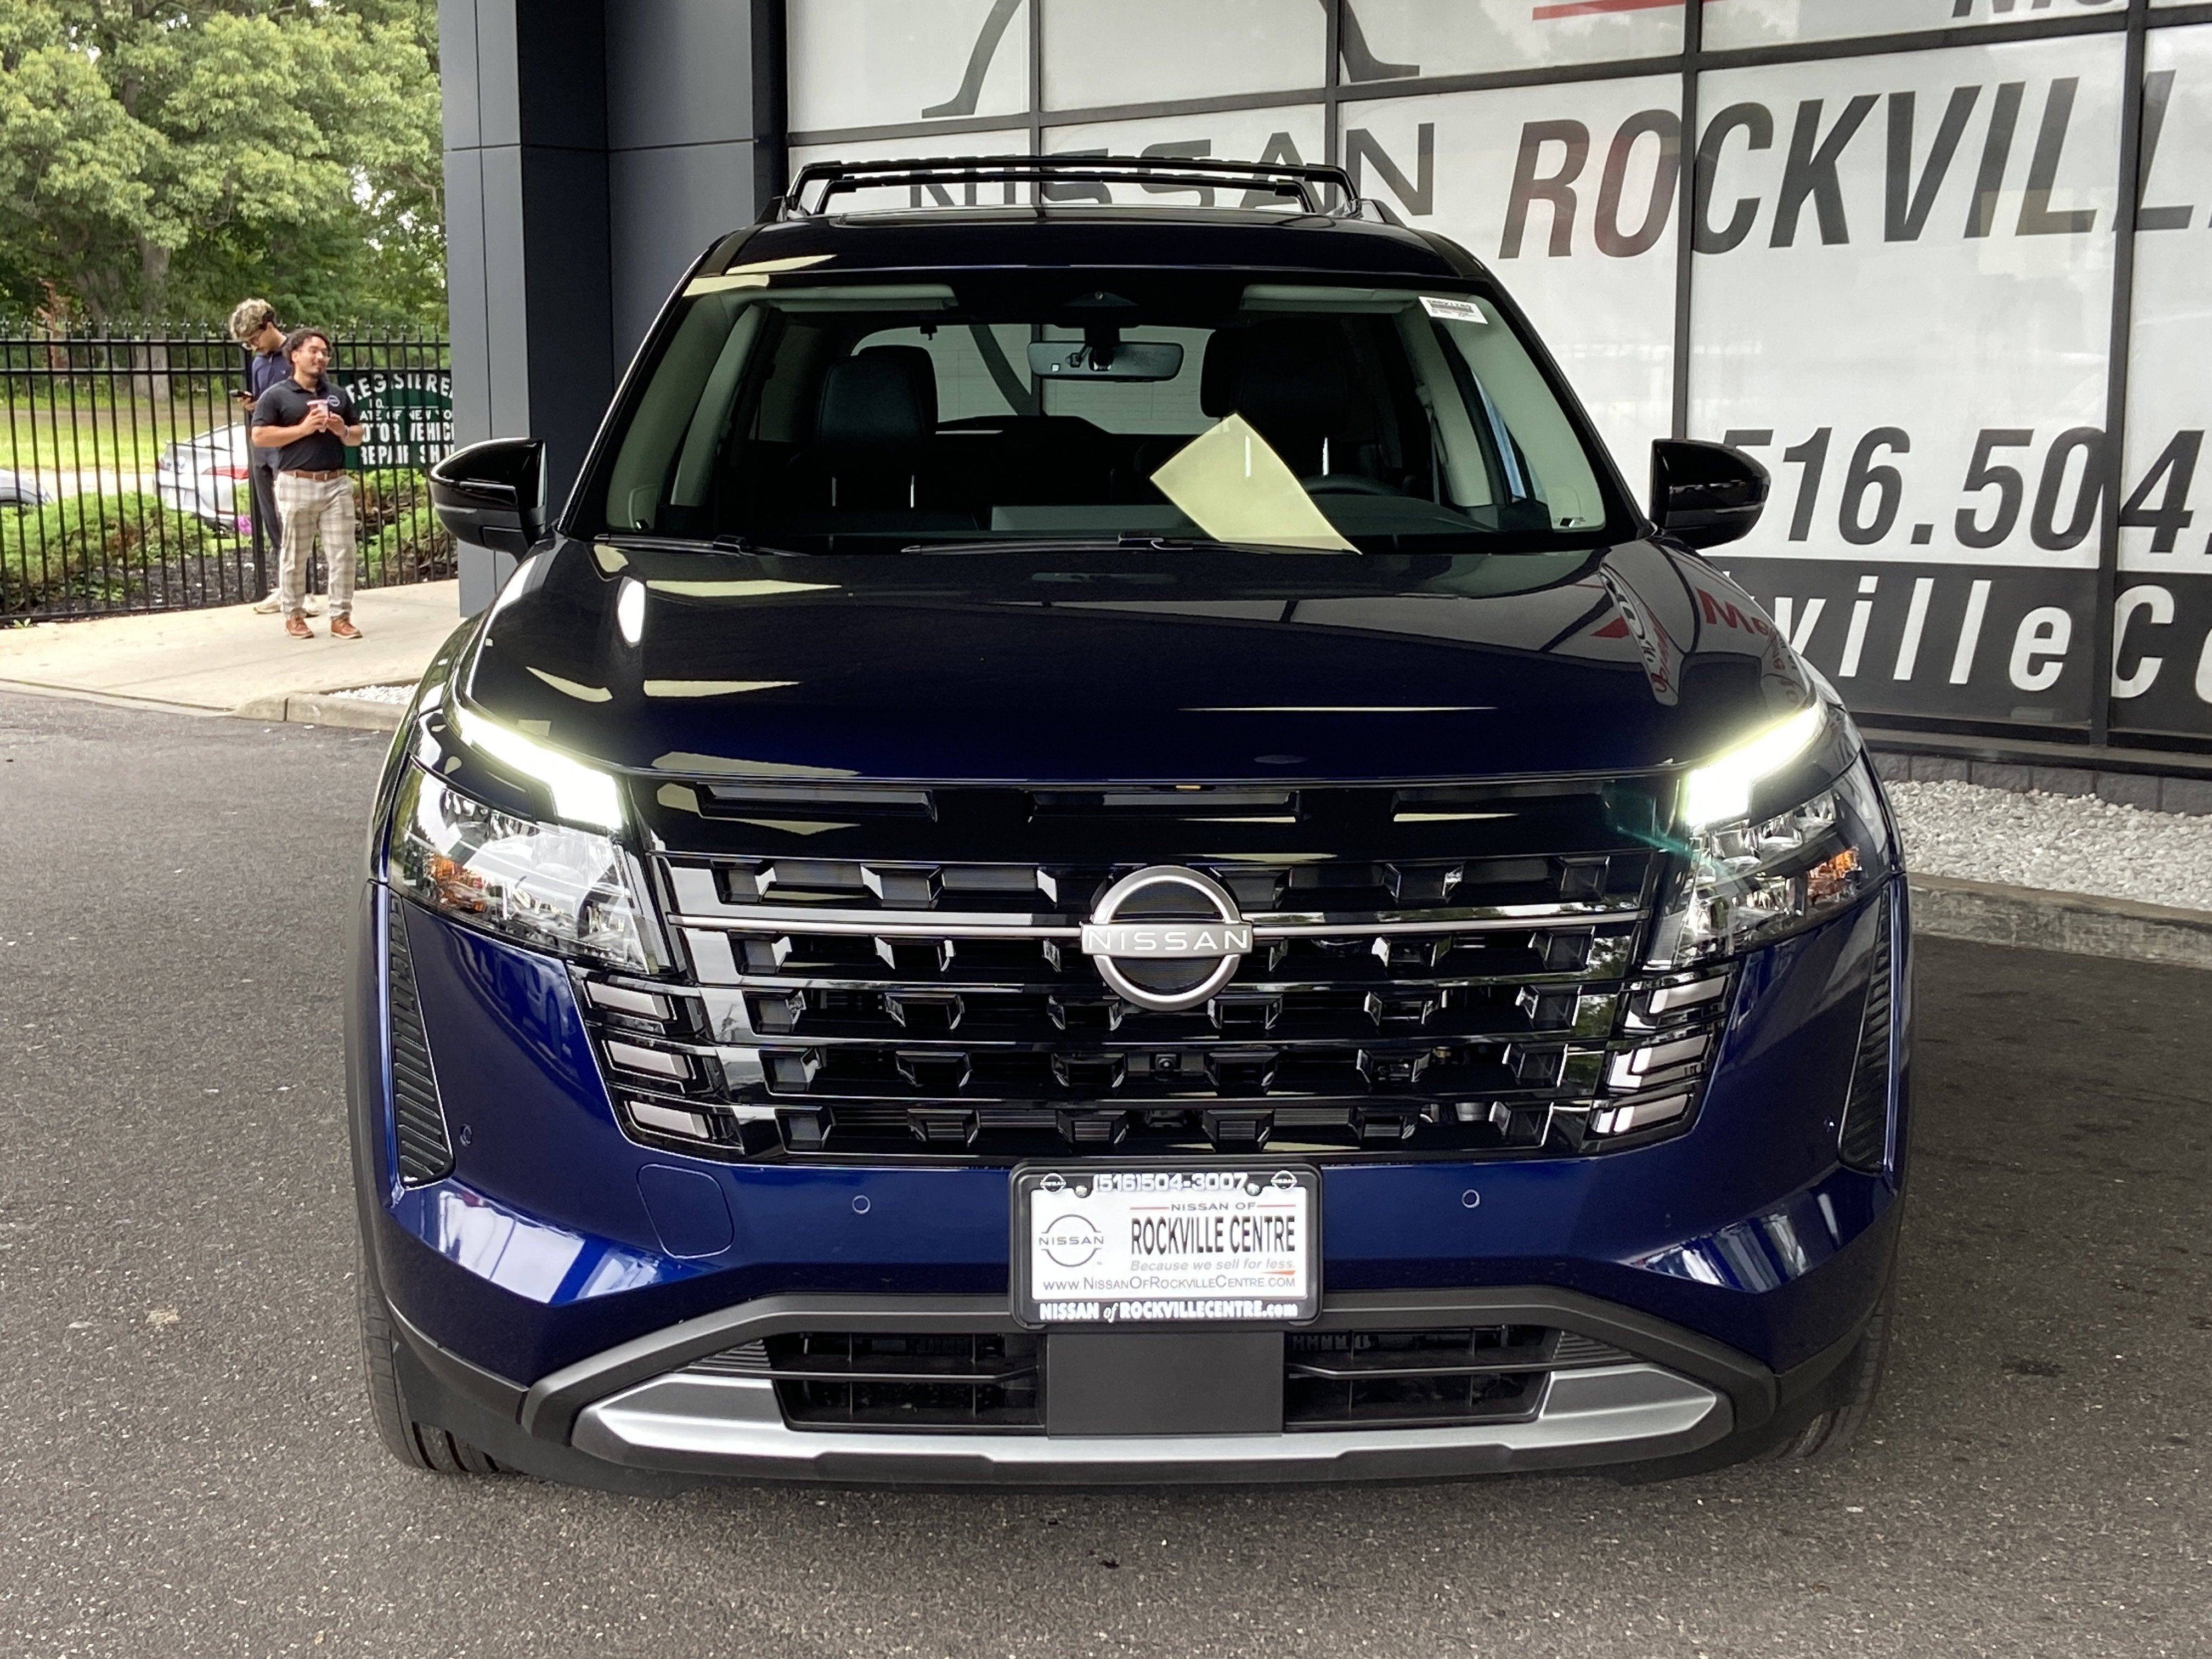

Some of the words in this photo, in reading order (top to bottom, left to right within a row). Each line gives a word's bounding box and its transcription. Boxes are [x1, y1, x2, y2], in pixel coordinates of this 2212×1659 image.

[1498, 69, 2212, 259] ROCKVILL
[1088, 929, 1248, 951] NISSAN
[1171, 1202, 1228, 1211] NISSAN
[1235, 1201, 1256, 1210] OF
[1039, 1235, 1104, 1246] NISSAN
[1131, 1216, 1224, 1255] ROCKVILLE
[1229, 1215, 1295, 1254] CENTRE
[1130, 1260, 1188, 1272] Because
[1193, 1262, 1212, 1270] we
[1215, 1258, 1239, 1269] sell
[1243, 1257, 1263, 1269] for
[1265, 1258, 1295, 1269] less.
[1040, 1302, 1099, 1321] NISSAN
[1103, 1302, 1119, 1323] of
[1120, 1299, 1299, 1319] ROCKVILLECENTRE.com
